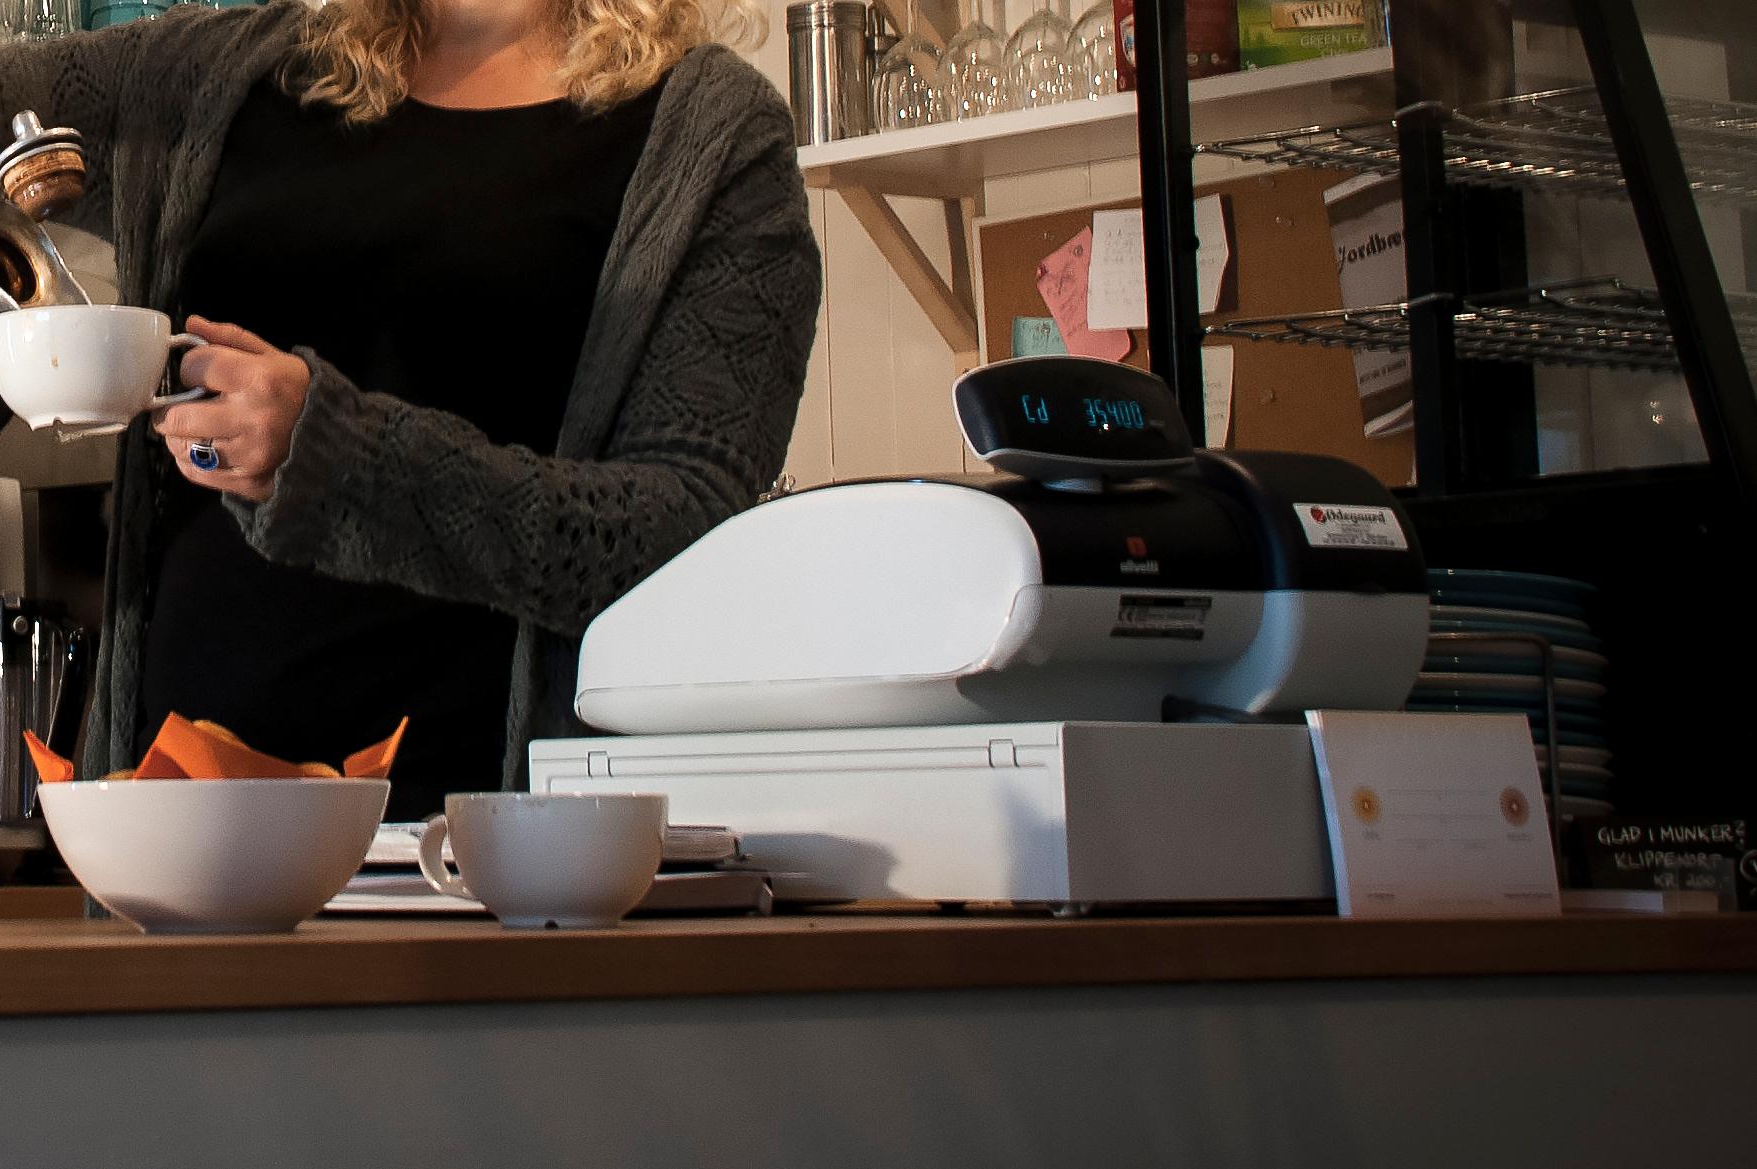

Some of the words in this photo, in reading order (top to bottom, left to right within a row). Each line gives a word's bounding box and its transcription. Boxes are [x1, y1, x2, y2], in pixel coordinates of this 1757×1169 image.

[1291, 1, 1364, 25] TWINING
[1300, 33, 1341, 48] GREEN
[1345, 32, 1368, 45] TEA
[1597, 825, 1642, 846] GLAD
[1649, 827, 1654, 843] I
